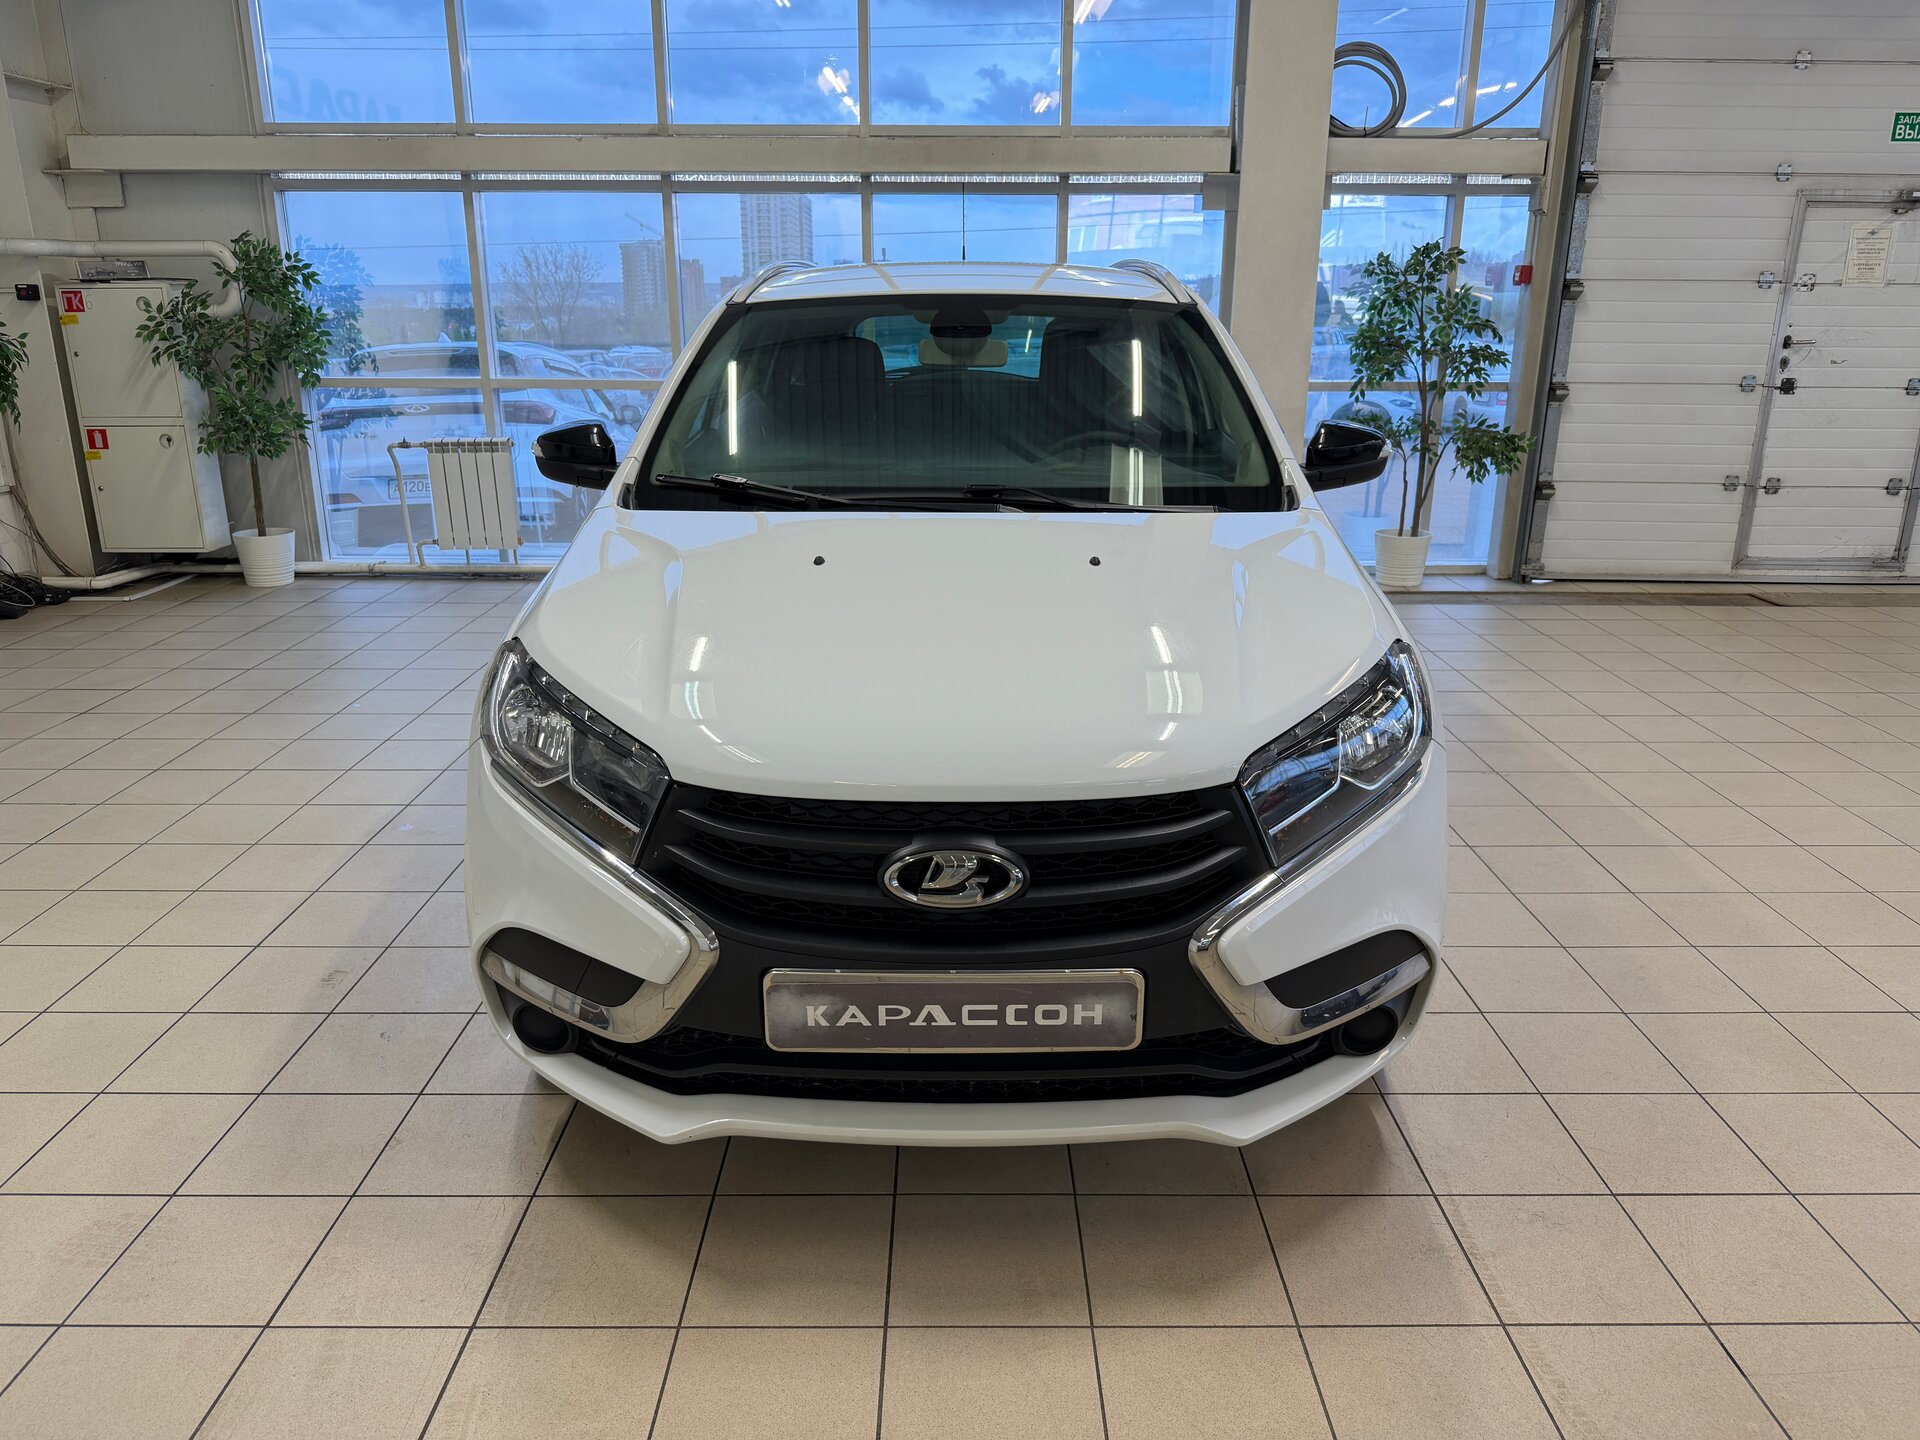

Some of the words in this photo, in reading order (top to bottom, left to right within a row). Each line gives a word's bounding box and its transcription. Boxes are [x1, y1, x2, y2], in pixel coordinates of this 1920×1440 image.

[1895, 124, 1920, 139] ВЫ
[63, 293, 84, 310] ПК
[806, 1004, 1103, 1026] КАРАССОН
